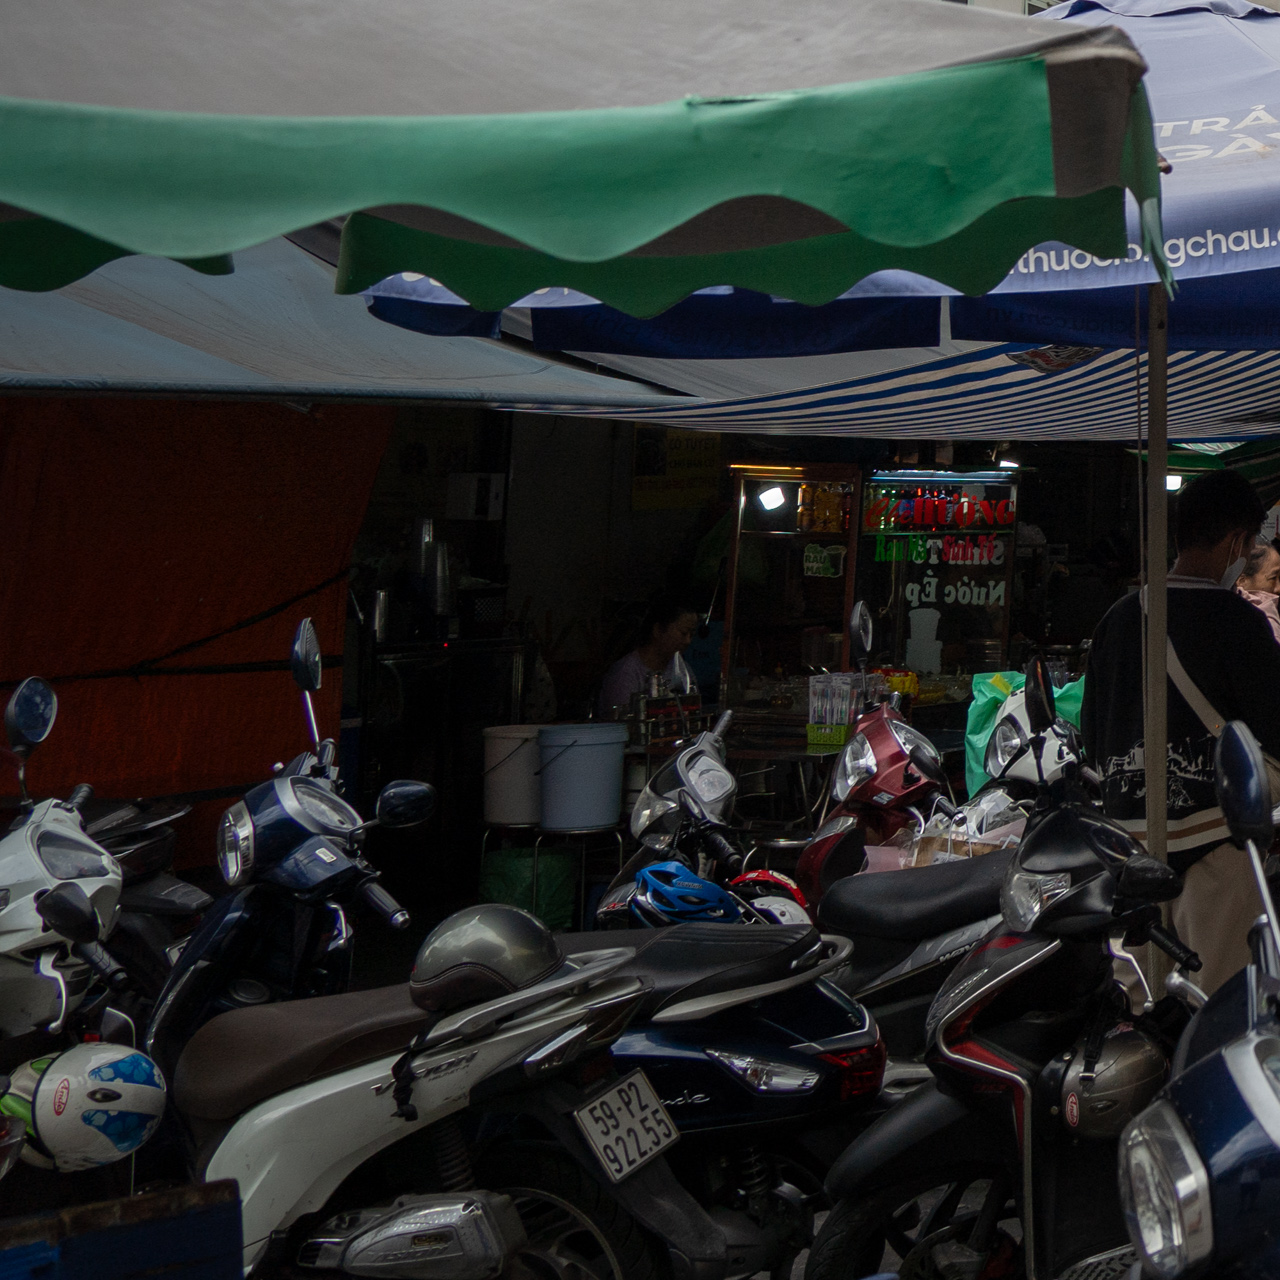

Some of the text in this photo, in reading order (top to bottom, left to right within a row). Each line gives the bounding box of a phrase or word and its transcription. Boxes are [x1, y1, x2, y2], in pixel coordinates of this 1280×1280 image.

[874, 534, 904, 562] Rau
[587, 1080, 650, 1137] 59-P2
[602, 1107, 674, 1175] 922.55
